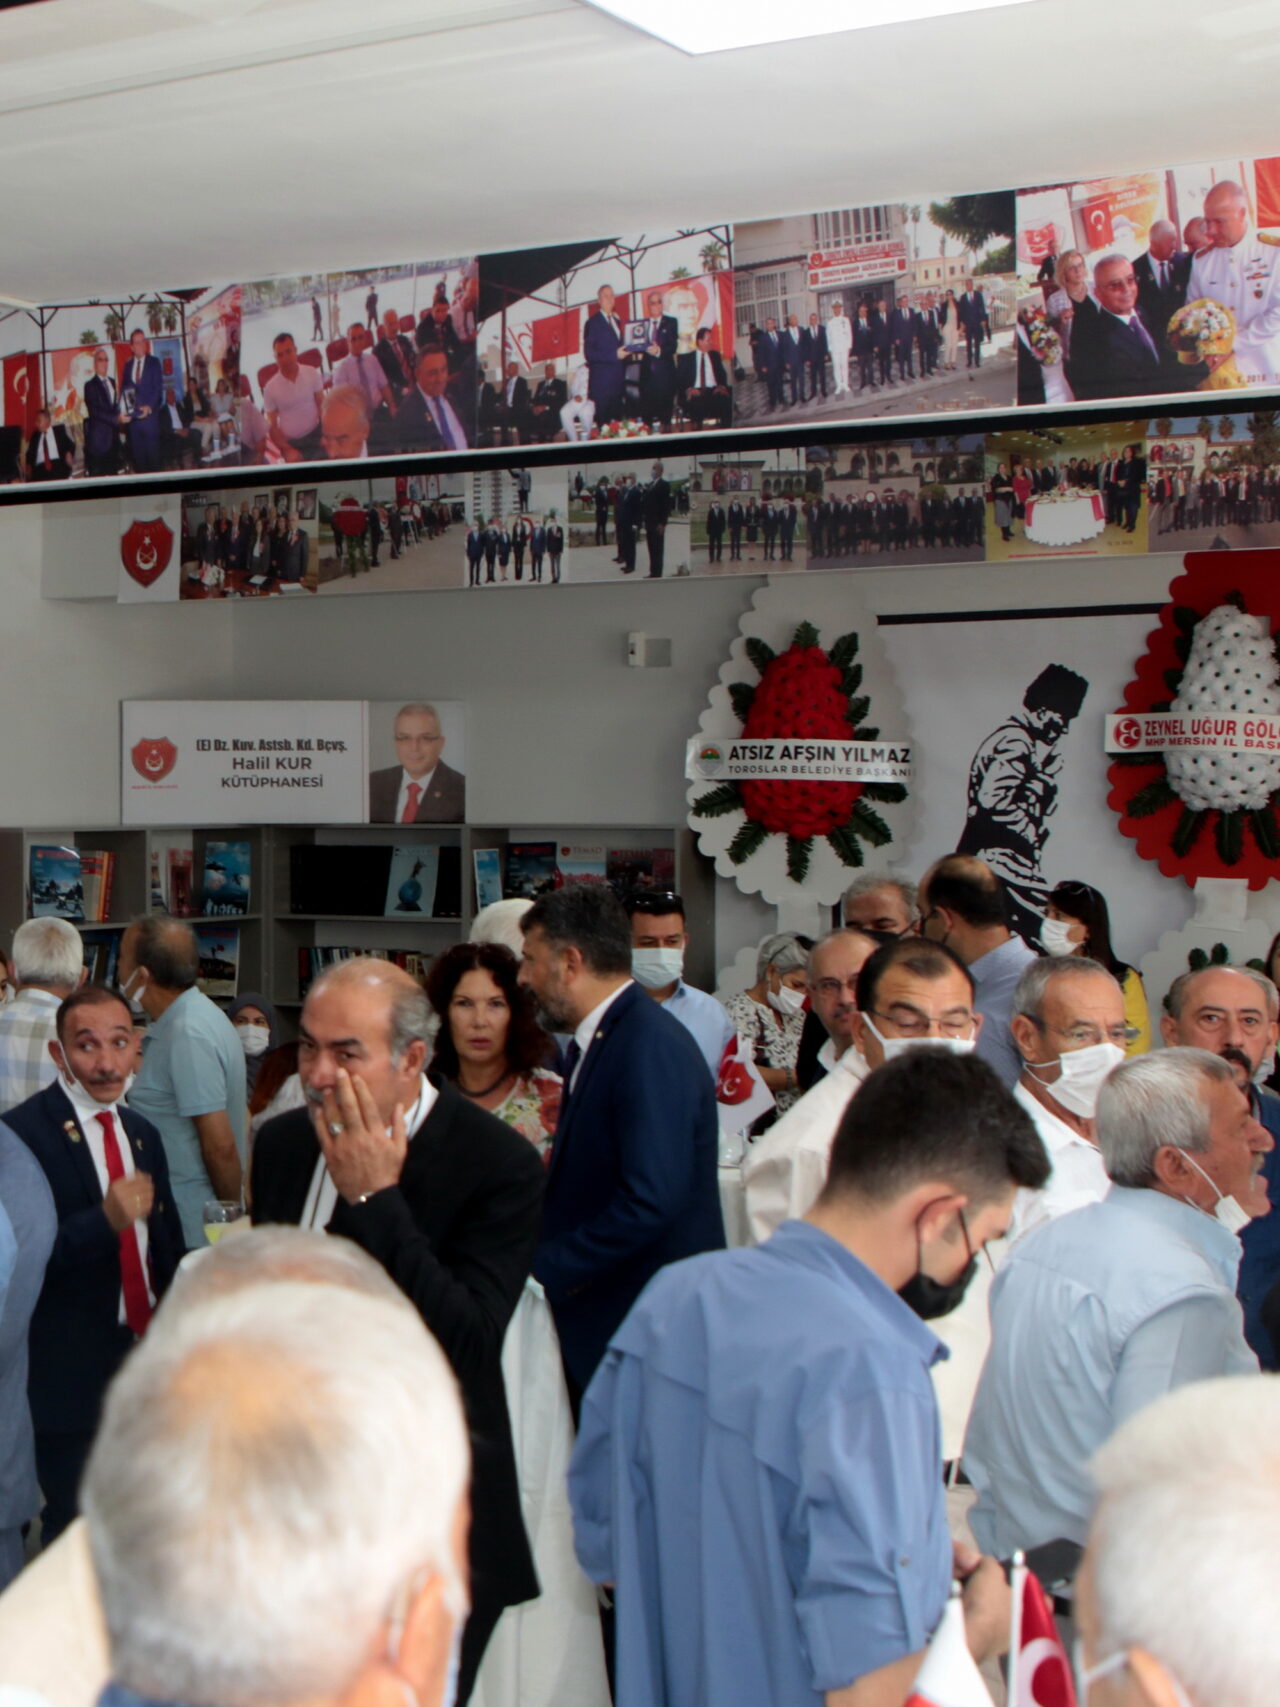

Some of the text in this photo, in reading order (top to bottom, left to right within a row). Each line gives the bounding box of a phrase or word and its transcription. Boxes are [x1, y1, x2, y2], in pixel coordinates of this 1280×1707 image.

[1145, 717, 1280, 739] ZEYNEL UĞUR GÖL
[214, 739, 230, 751] Dz.
[232, 739, 256, 751] Kuv.
[259, 738, 294, 751] Astsb.
[296, 738, 314, 751] Kd.
[317, 739, 348, 753] Bçvş.
[1145, 738, 1166, 747] MHP
[728, 745, 775, 761] ATSIZ
[841, 748, 911, 763] YILMAZ
[232, 757, 312, 770] Halil KUR
[728, 765, 788, 774] TOROSLAR
[791, 765, 852, 775] BELEDİYE
[221, 774, 323, 788] KÜTÜPHANESİ
